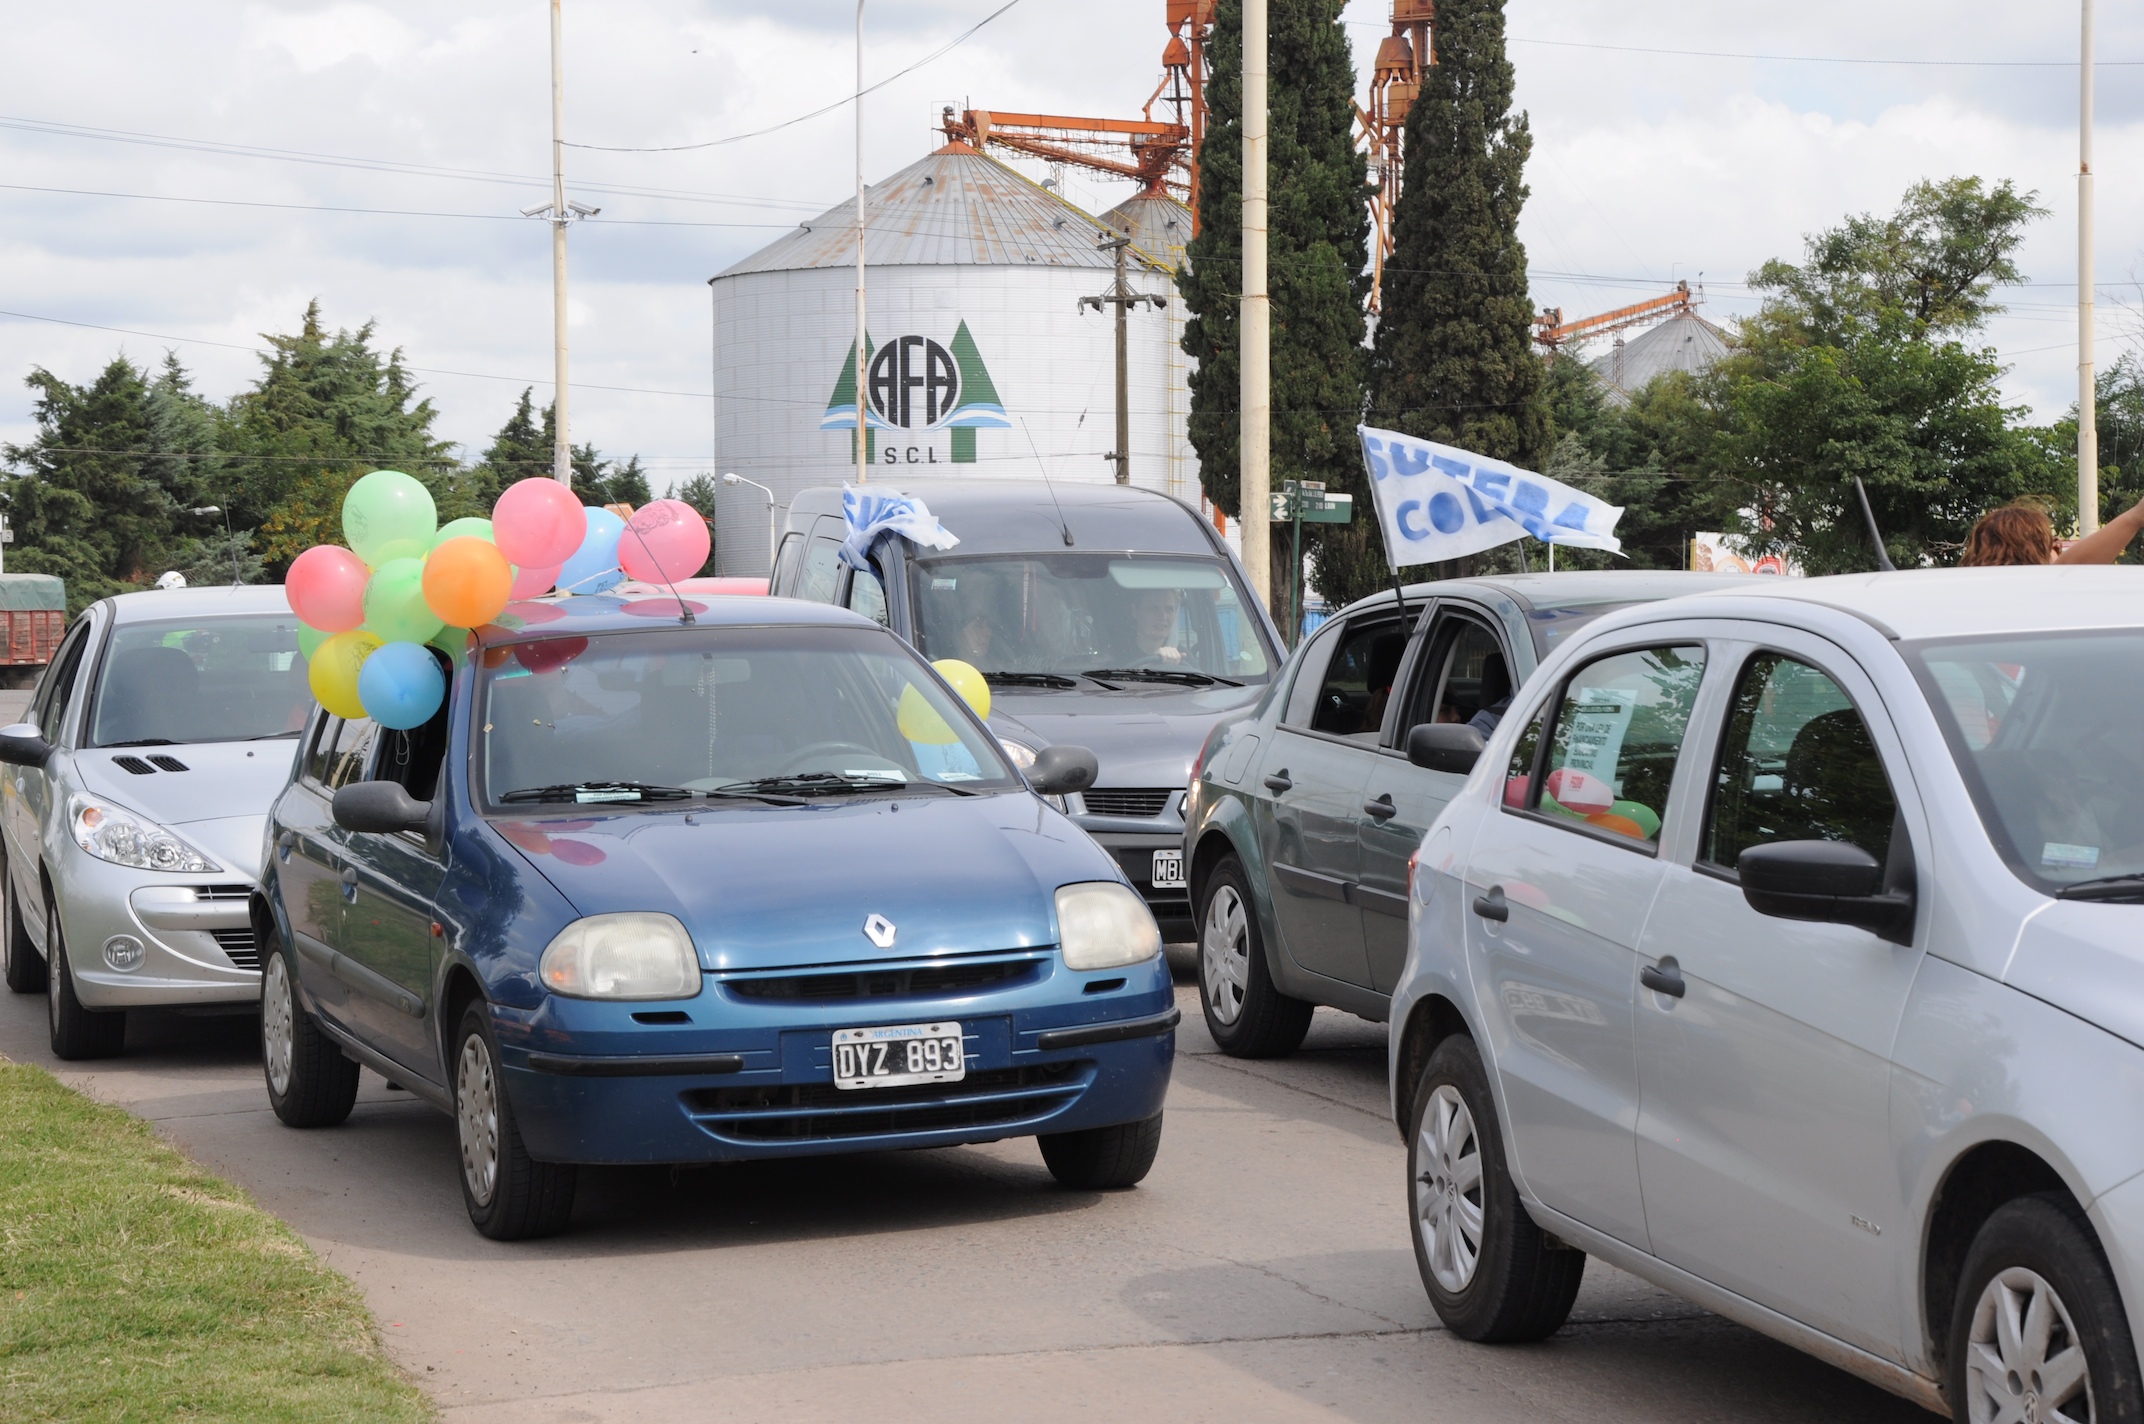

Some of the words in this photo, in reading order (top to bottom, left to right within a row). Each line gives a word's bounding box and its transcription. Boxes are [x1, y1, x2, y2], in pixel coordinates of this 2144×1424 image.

[869, 335, 957, 428] AFA
[871, 1027, 923, 1039] ARGENTINA
[838, 1041, 890, 1078] DYZ
[906, 1038, 960, 1073] 893
